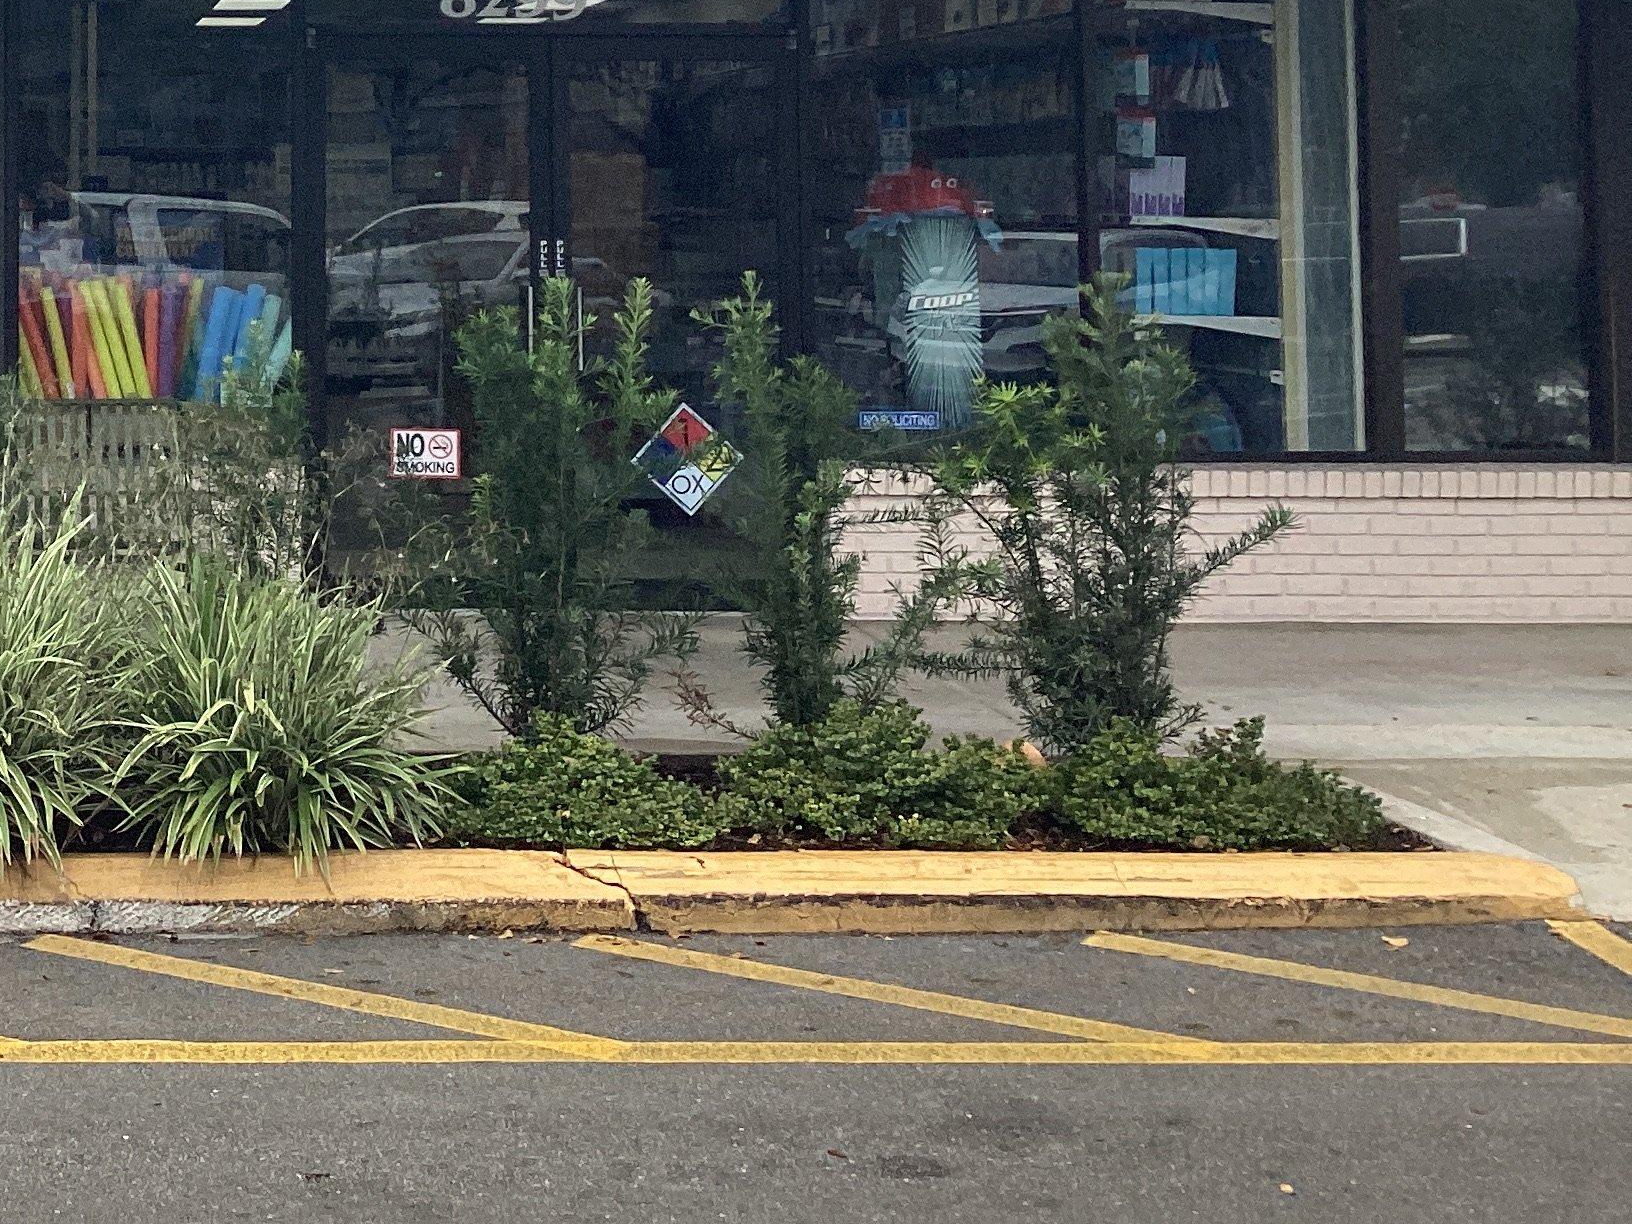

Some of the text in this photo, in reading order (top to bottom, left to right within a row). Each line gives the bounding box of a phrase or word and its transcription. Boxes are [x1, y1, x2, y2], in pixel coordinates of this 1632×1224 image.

[396, 433, 425, 458] NO
[396, 461, 455, 474] SMOKING
[671, 474, 706, 495] OX
